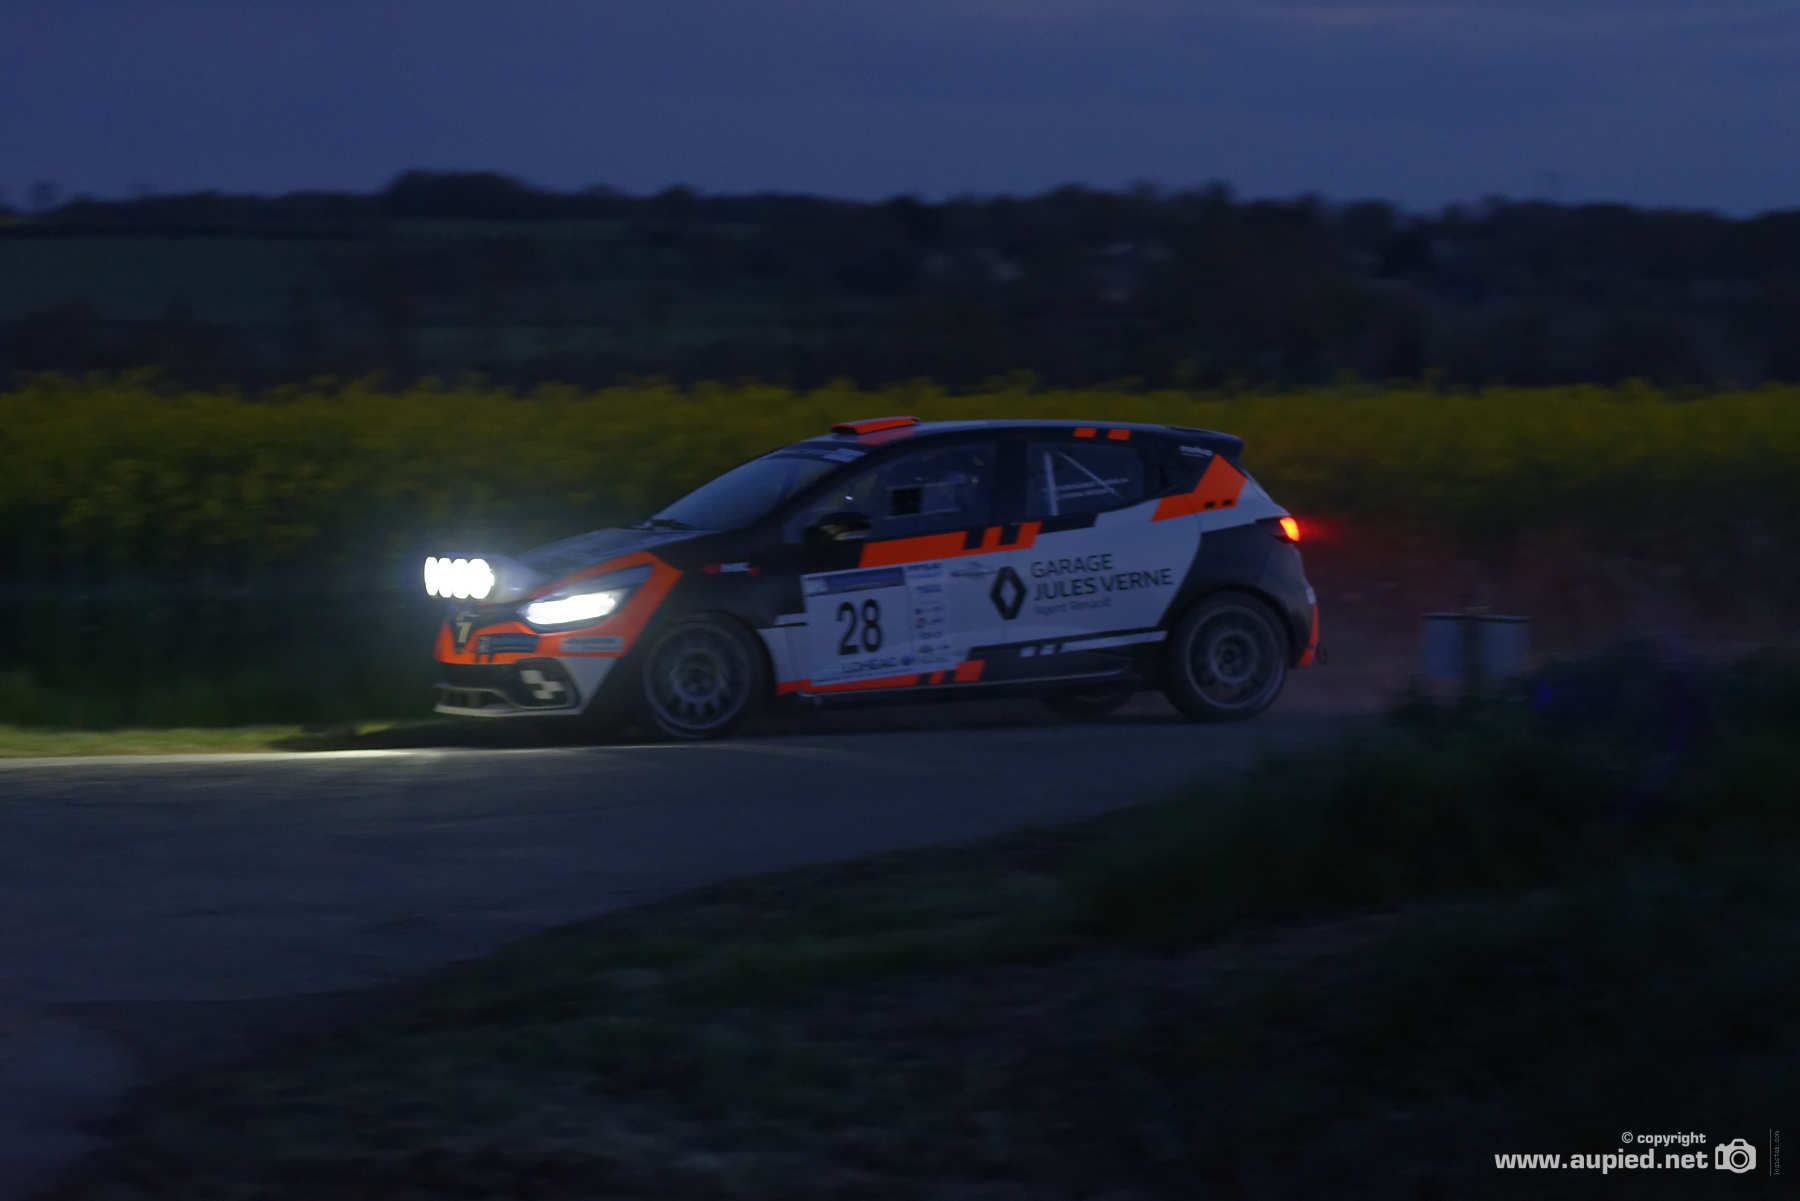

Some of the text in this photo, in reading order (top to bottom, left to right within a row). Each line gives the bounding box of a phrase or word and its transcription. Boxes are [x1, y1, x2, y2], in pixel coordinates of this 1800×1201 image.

[1031, 553, 1113, 578] GARAGE
[1034, 568, 1174, 601] JULES VERNE
[837, 598, 882, 656] 28
